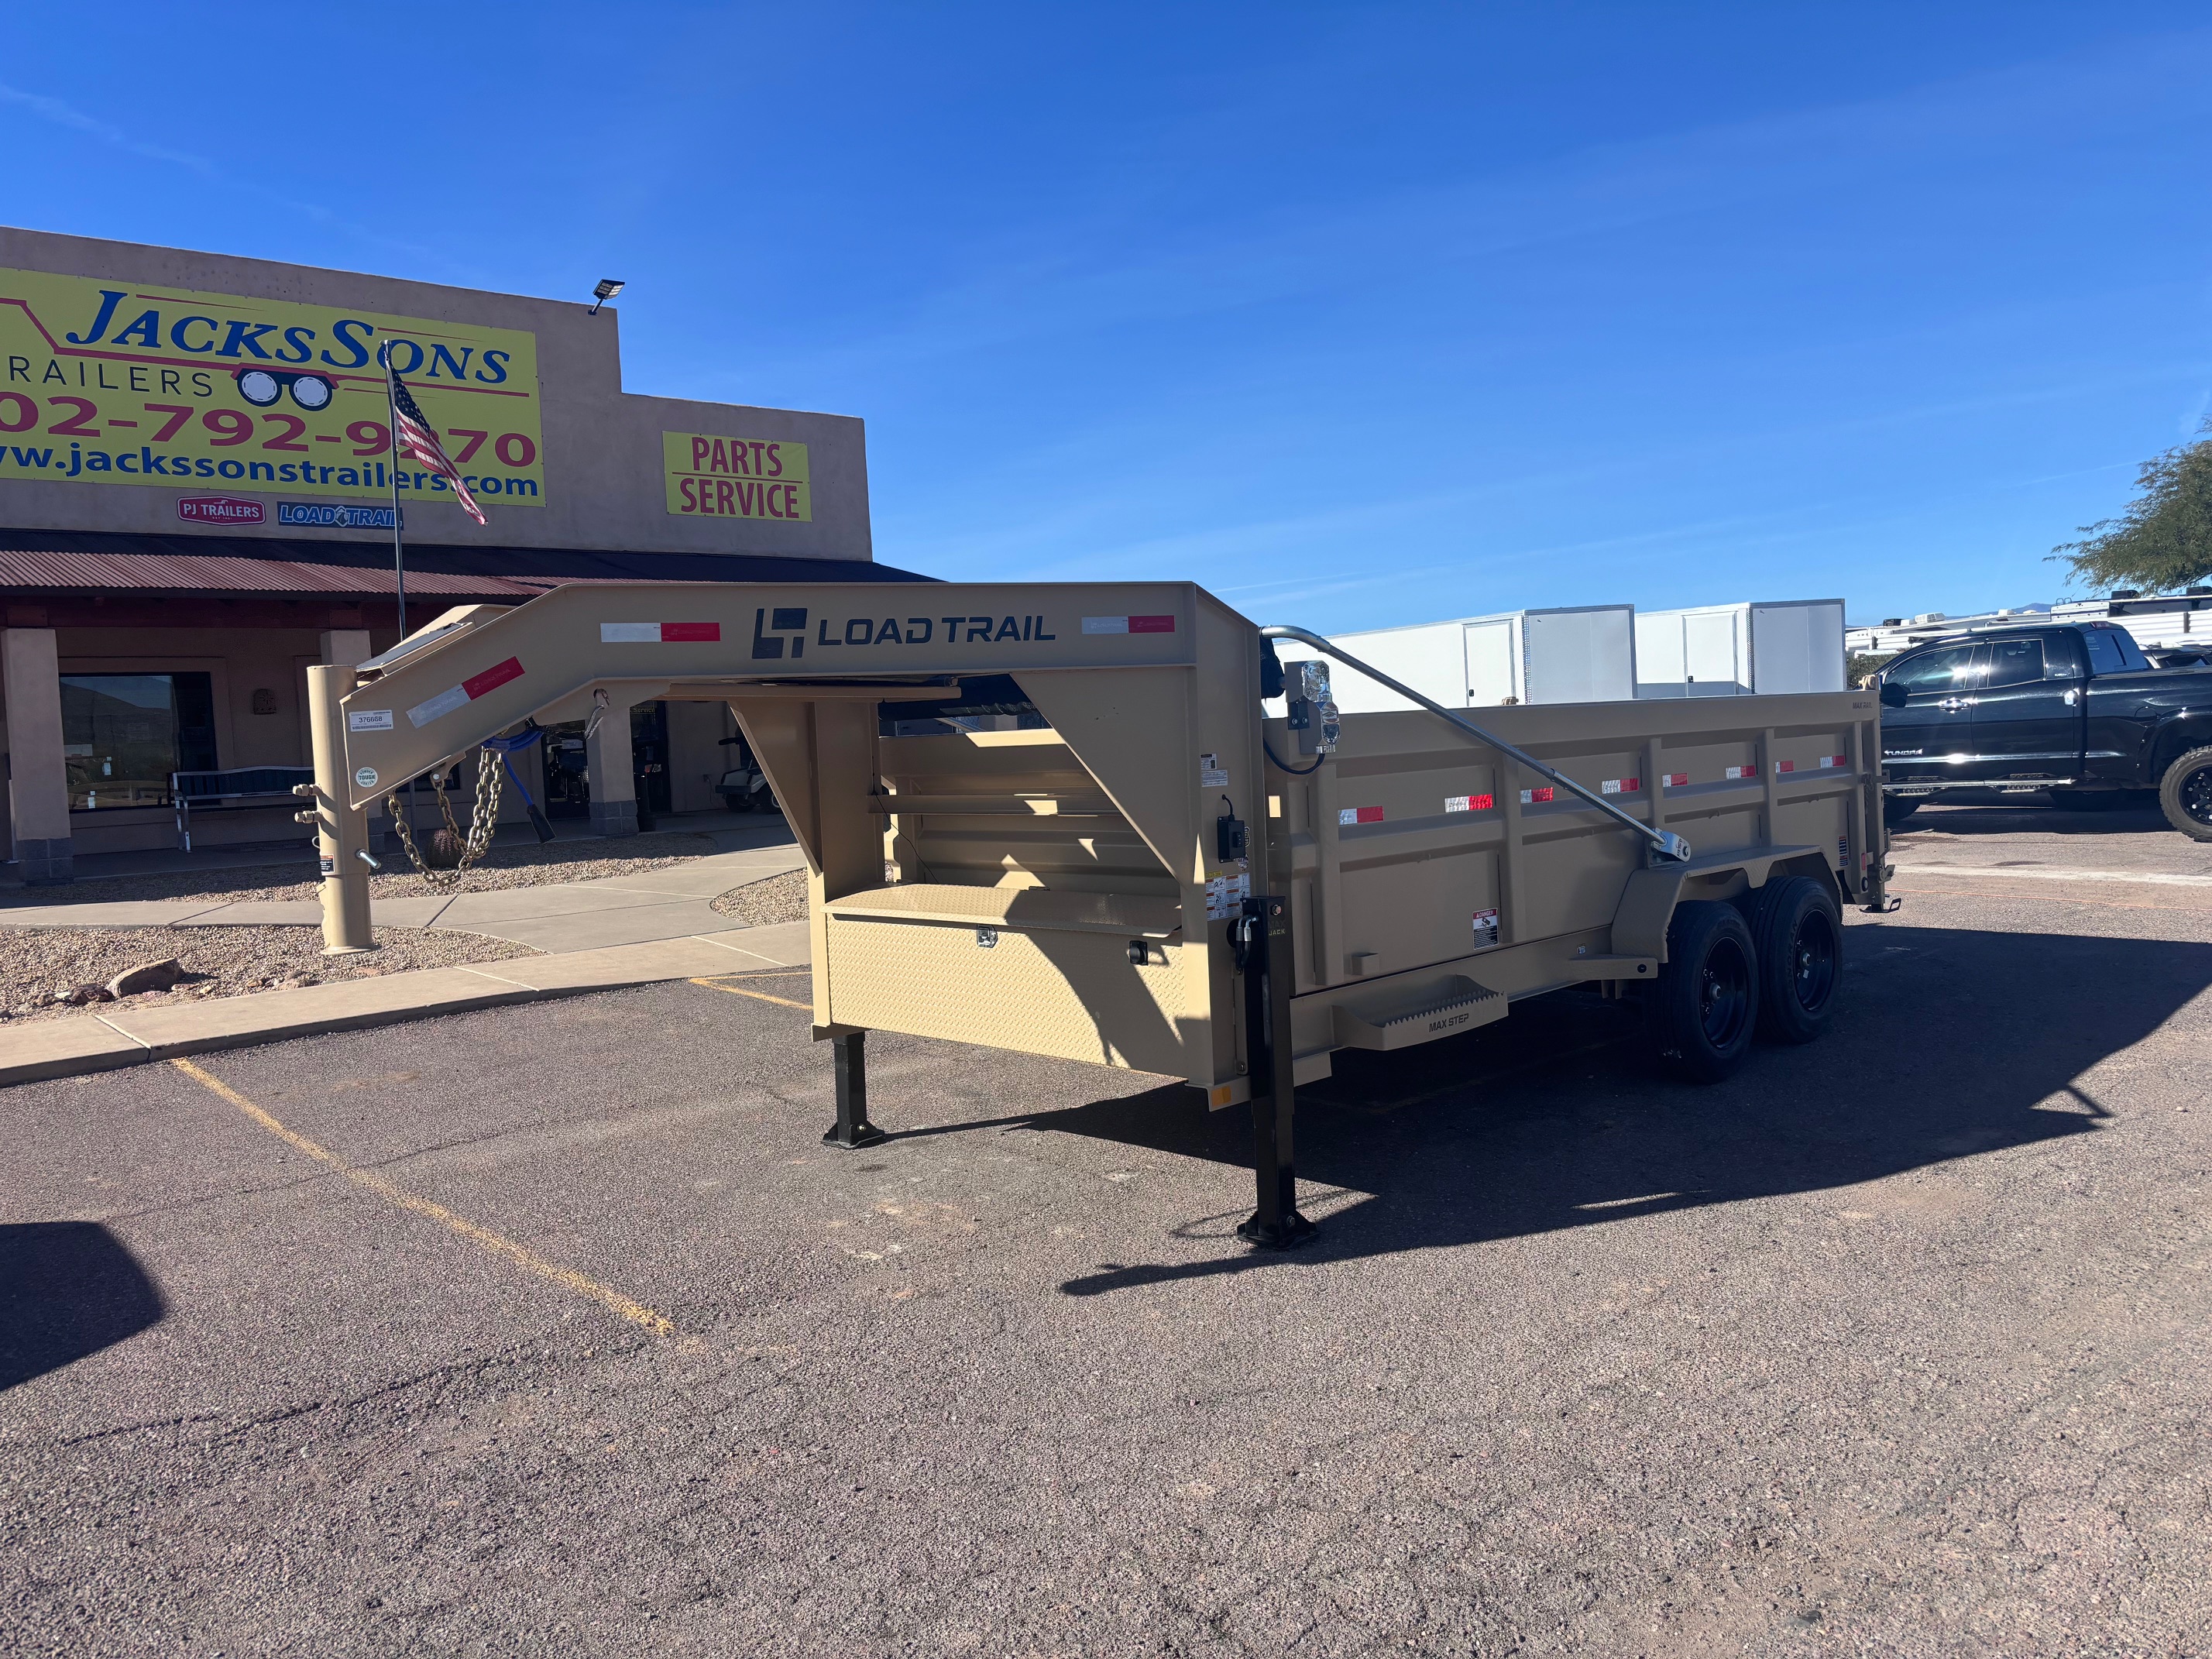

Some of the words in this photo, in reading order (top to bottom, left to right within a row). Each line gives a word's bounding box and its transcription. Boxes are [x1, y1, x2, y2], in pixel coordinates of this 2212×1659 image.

[0, 391, 537, 467] 02-792-970
[0, 442, 538, 496] w.jackssonstrailers.com
[692, 437, 783, 477] PARTS
[183, 503, 197, 515] PJ
[201, 503, 259, 518] TRAILERS
[679, 477, 800, 519] SERVICE
[280, 505, 336, 524] LOAD
[818, 617, 933, 646] LOAD
[940, 615, 1056, 644] TRAIL
[1479, 909, 1494, 918] DANGER
[1428, 1018, 1448, 1033] MAX
[1448, 1012, 1469, 1027] STEP
